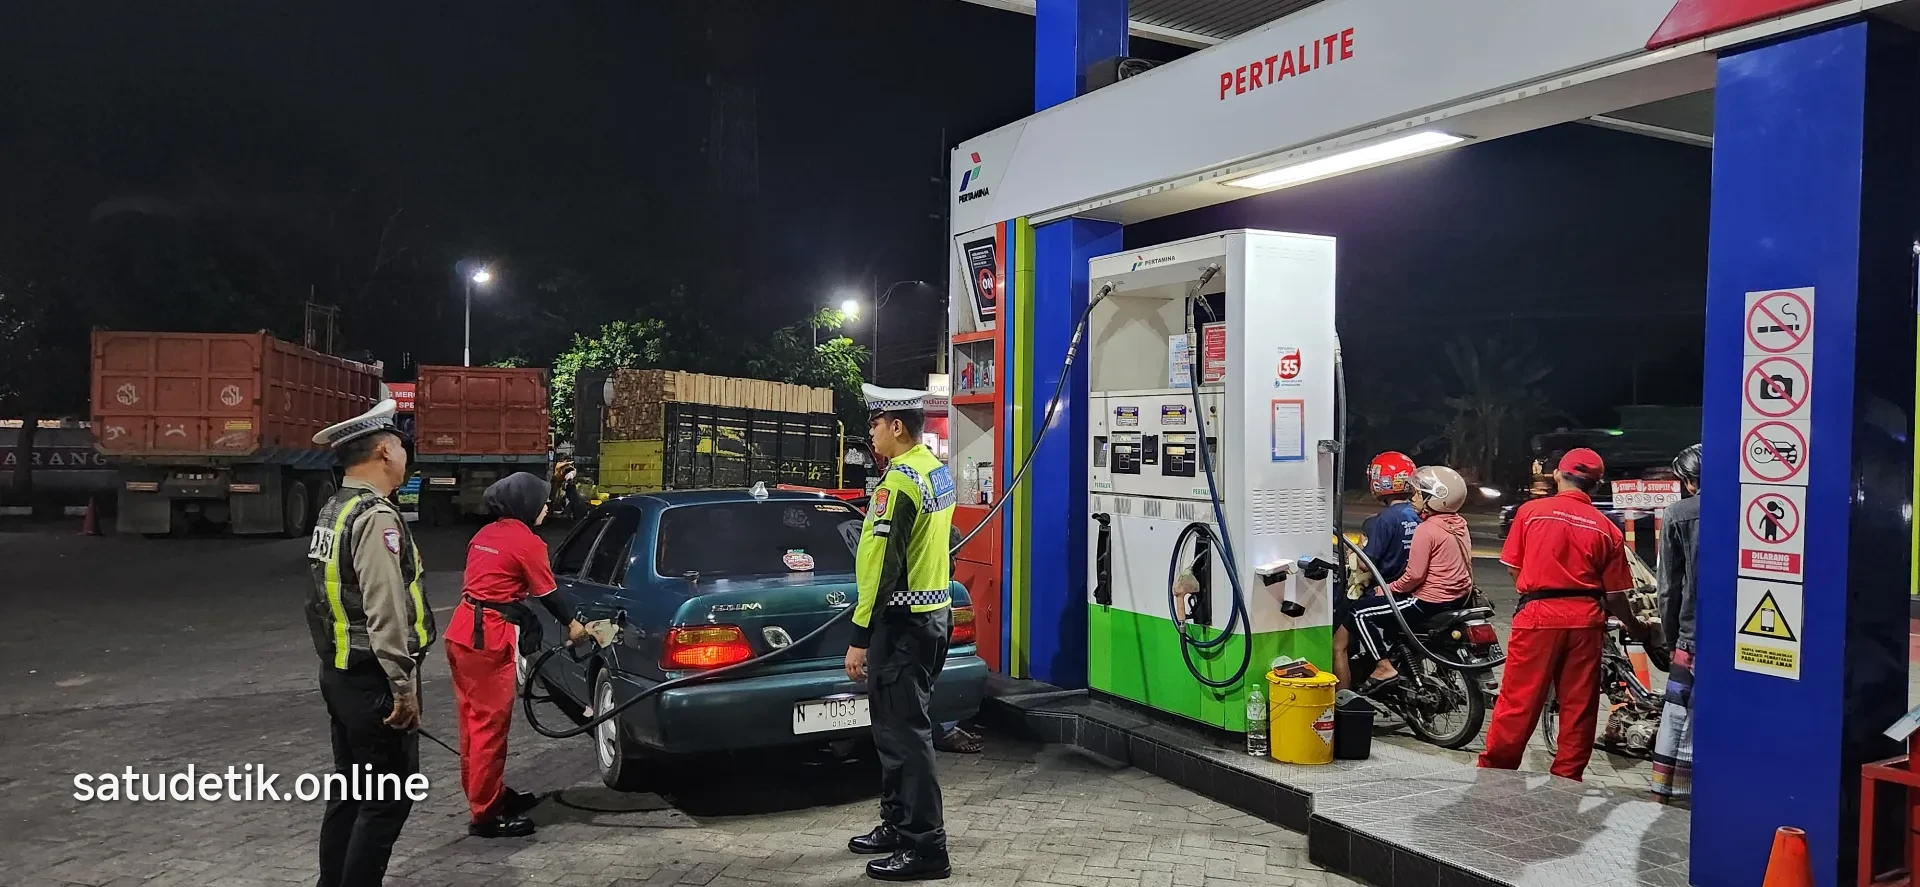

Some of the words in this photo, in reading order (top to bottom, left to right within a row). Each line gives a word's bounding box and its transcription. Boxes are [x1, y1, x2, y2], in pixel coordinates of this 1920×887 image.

[1220, 27, 1354, 101] PERTALITE
[958, 186, 990, 204] PERTAMINA
[1144, 255, 1176, 266] PERTAMINA
[1752, 551, 1790, 562] DILARANG
[797, 703, 806, 723] N
[824, 698, 856, 719] 1053
